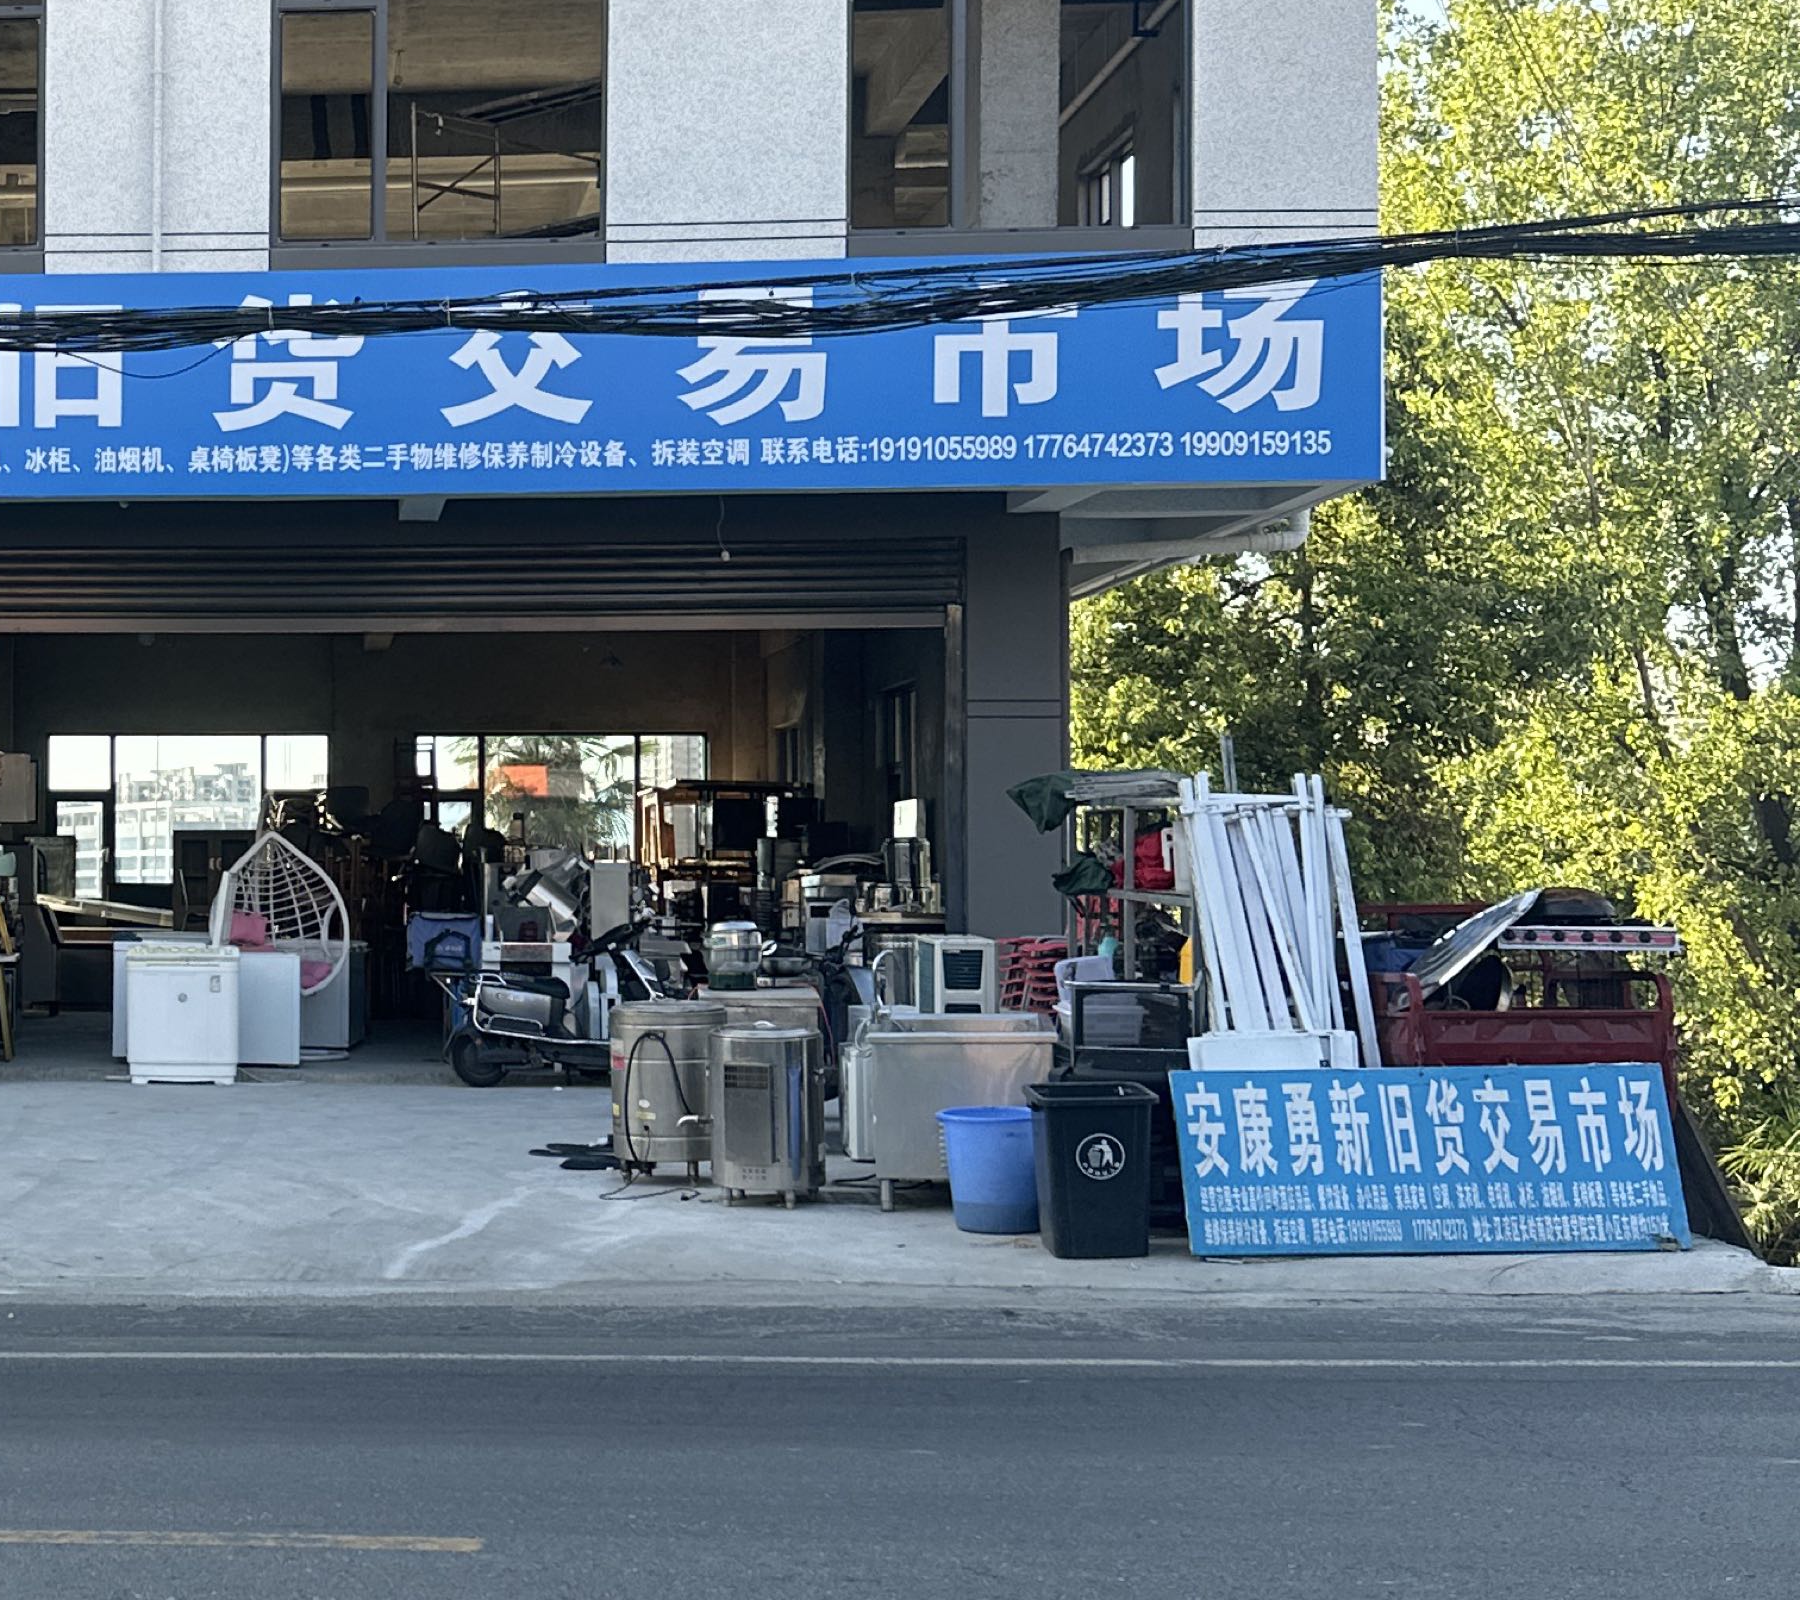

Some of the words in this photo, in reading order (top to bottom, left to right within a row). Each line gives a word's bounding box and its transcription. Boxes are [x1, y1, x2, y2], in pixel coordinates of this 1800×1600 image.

[759, 434, 1017, 466] 联系电话:19191055989
[1023, 431, 1174, 459] 17764742373
[1180, 429, 1332, 457] 19909159135
[1184, 1075, 1666, 1178] 安康勇新旧货交易市场
